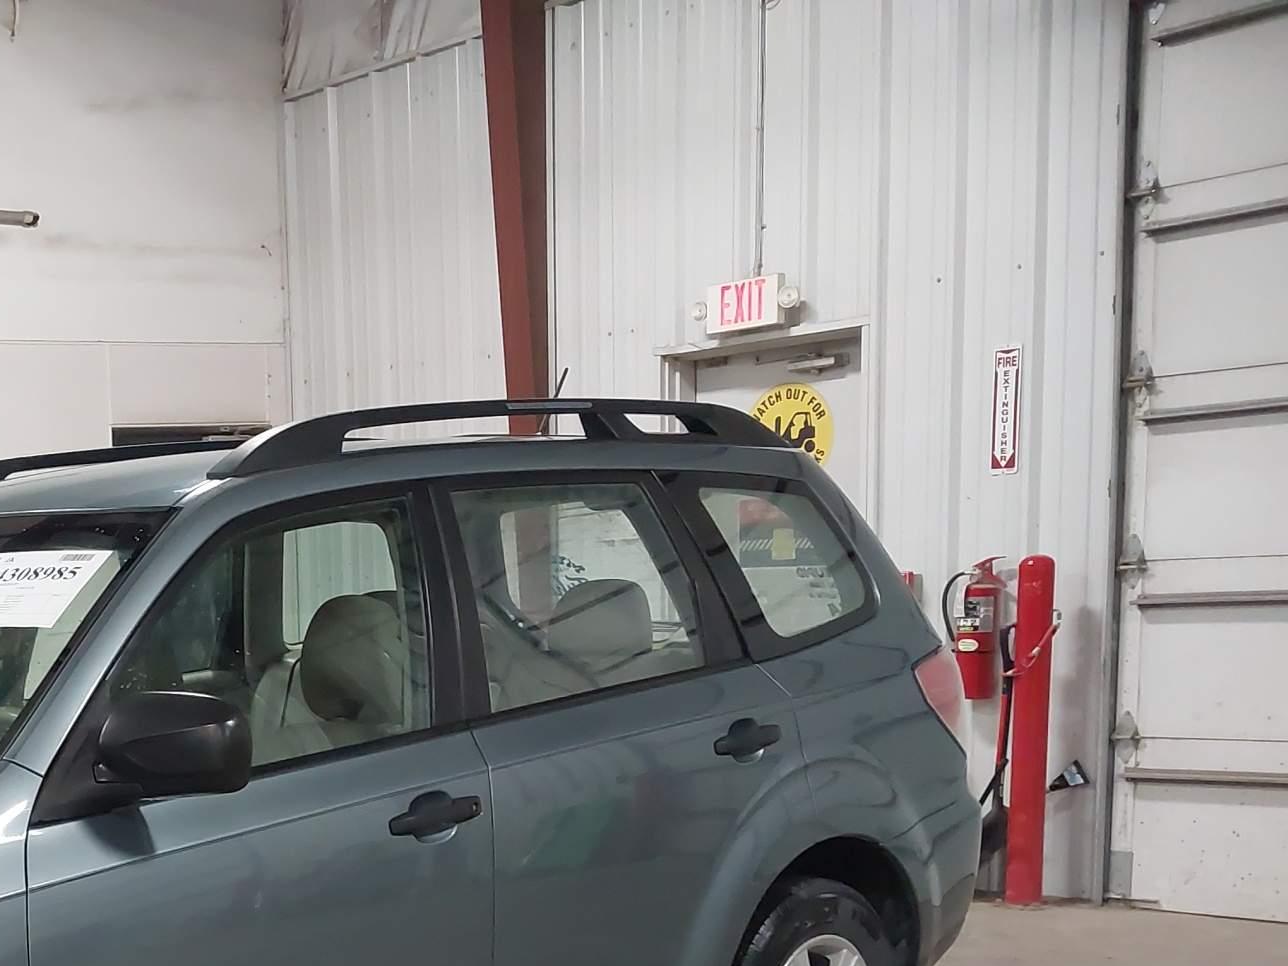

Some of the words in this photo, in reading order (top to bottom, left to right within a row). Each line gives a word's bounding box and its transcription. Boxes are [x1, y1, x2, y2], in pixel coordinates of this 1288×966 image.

[720, 279, 766, 326] EXIT
[997, 355, 1017, 368] FIRE
[786, 388, 808, 402] OUT
[807, 396, 826, 420] FOR
[1000, 370, 1010, 461] EXTINGUISHER
